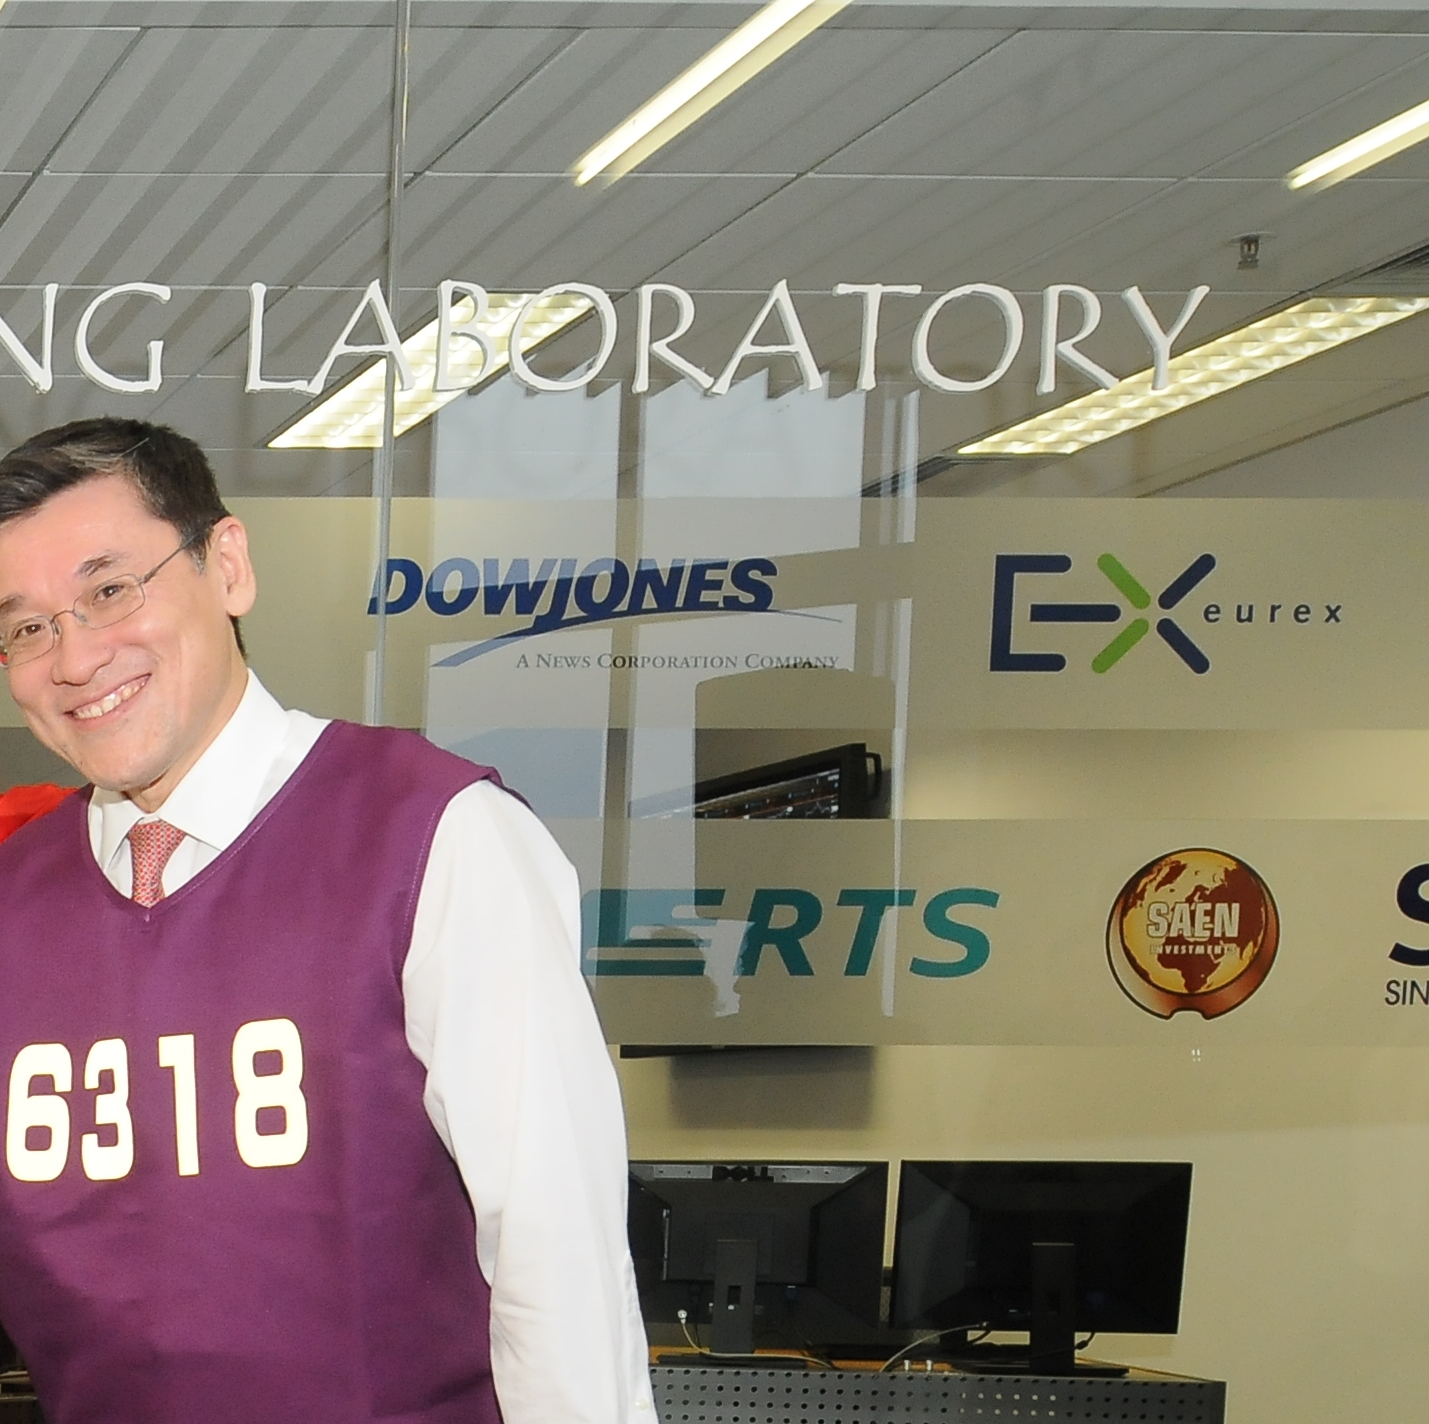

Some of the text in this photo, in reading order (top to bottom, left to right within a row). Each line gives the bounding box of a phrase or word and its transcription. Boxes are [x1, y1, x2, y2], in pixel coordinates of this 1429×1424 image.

[245, 279, 1209, 395] LABORATORY
[1203, 604, 1342, 623] eurex
[516, 654, 529, 668] A
[1147, 902, 1240, 939] SAEN
[1384, 979, 1429, 1006] SIN
[5, 1017, 310, 1183] 6318
